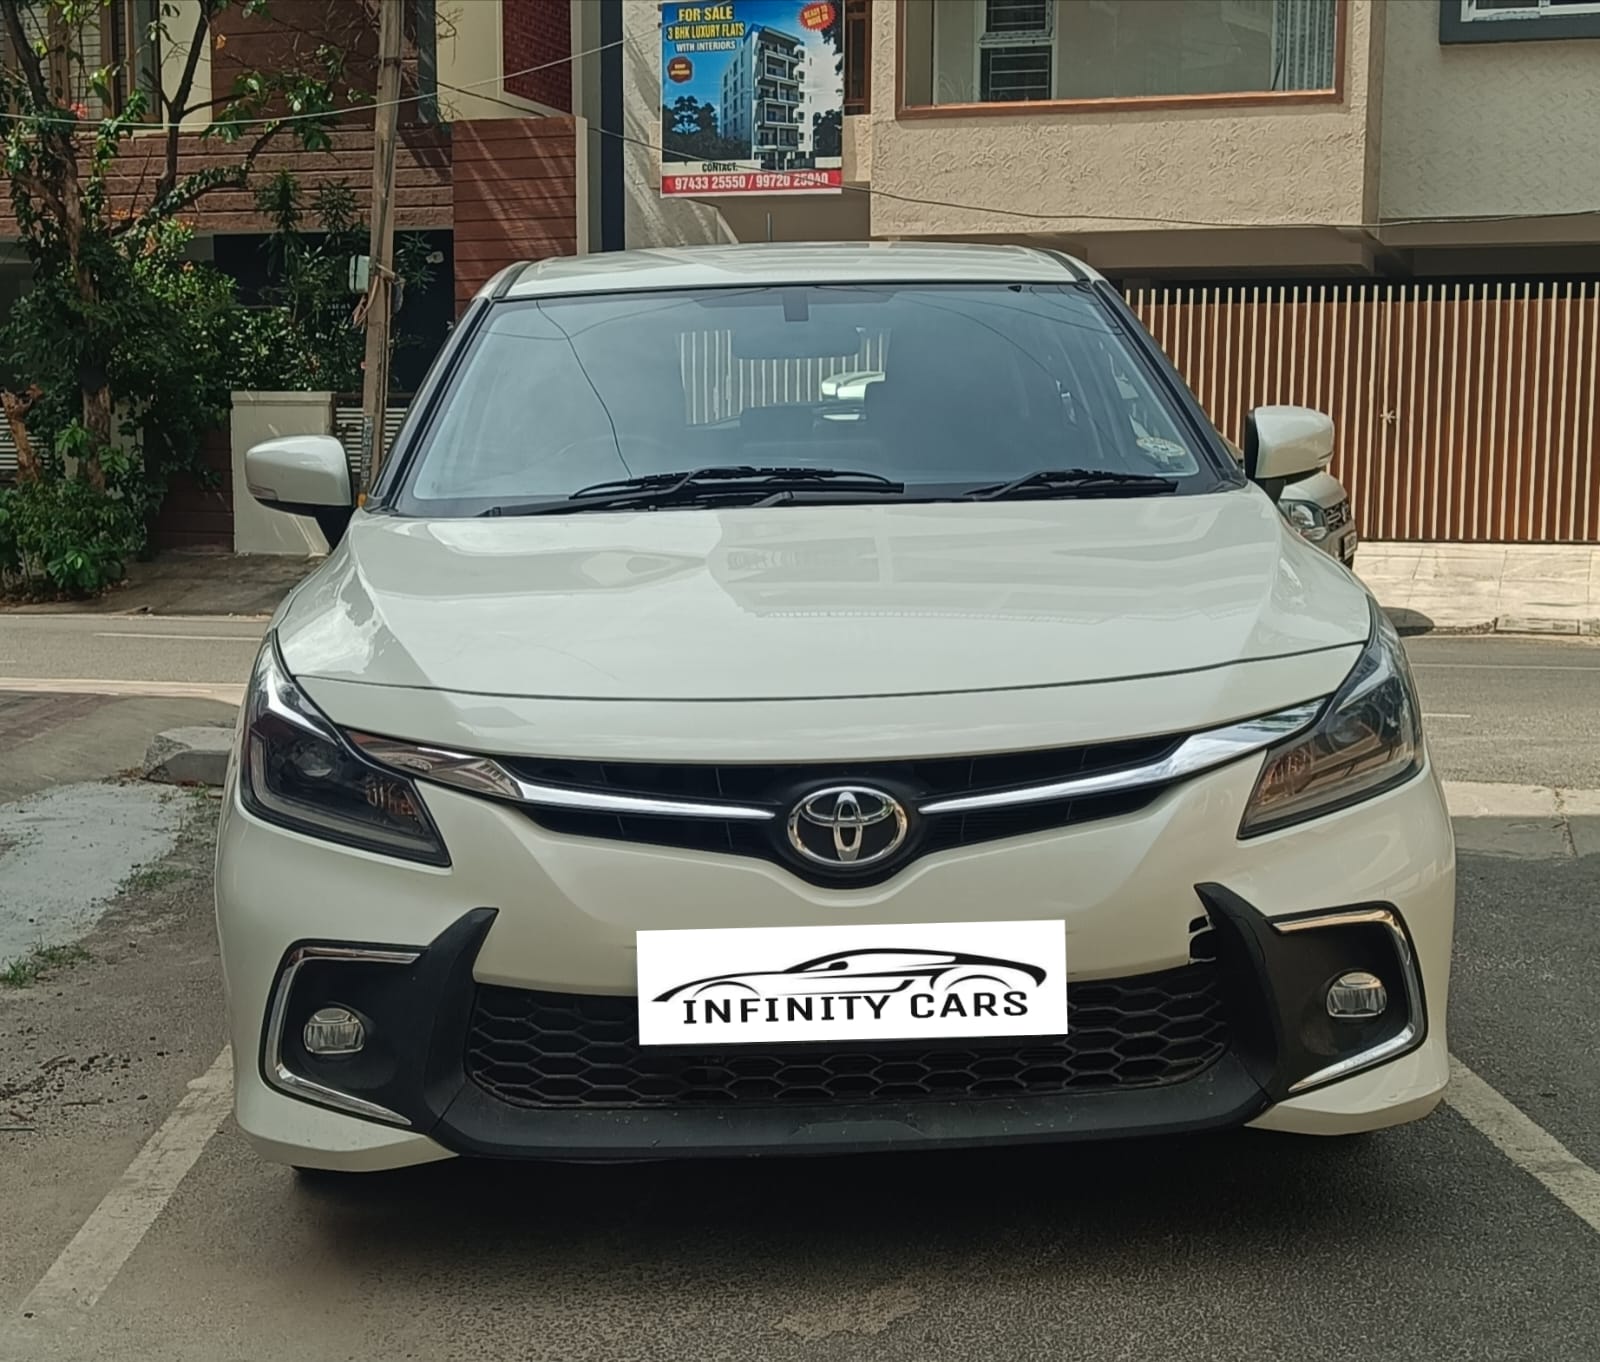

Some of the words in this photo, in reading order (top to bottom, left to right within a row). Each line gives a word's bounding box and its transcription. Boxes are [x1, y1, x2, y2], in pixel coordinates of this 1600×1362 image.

[679, 8, 701, 21] FOR
[704, 6, 734, 20] SALE
[667, 27, 673, 40] 3
[675, 26, 690, 39] BHK
[692, 24, 720, 38] LUXURY
[722, 22, 744, 37] FLATS
[676, 43, 695, 52] WITH
[697, 40, 736, 51] INTERIORS
[675, 177, 709, 190] 97433
[711, 175, 746, 189] 25550
[748, 175, 754, 189] /
[756, 174, 790, 188] 99720
